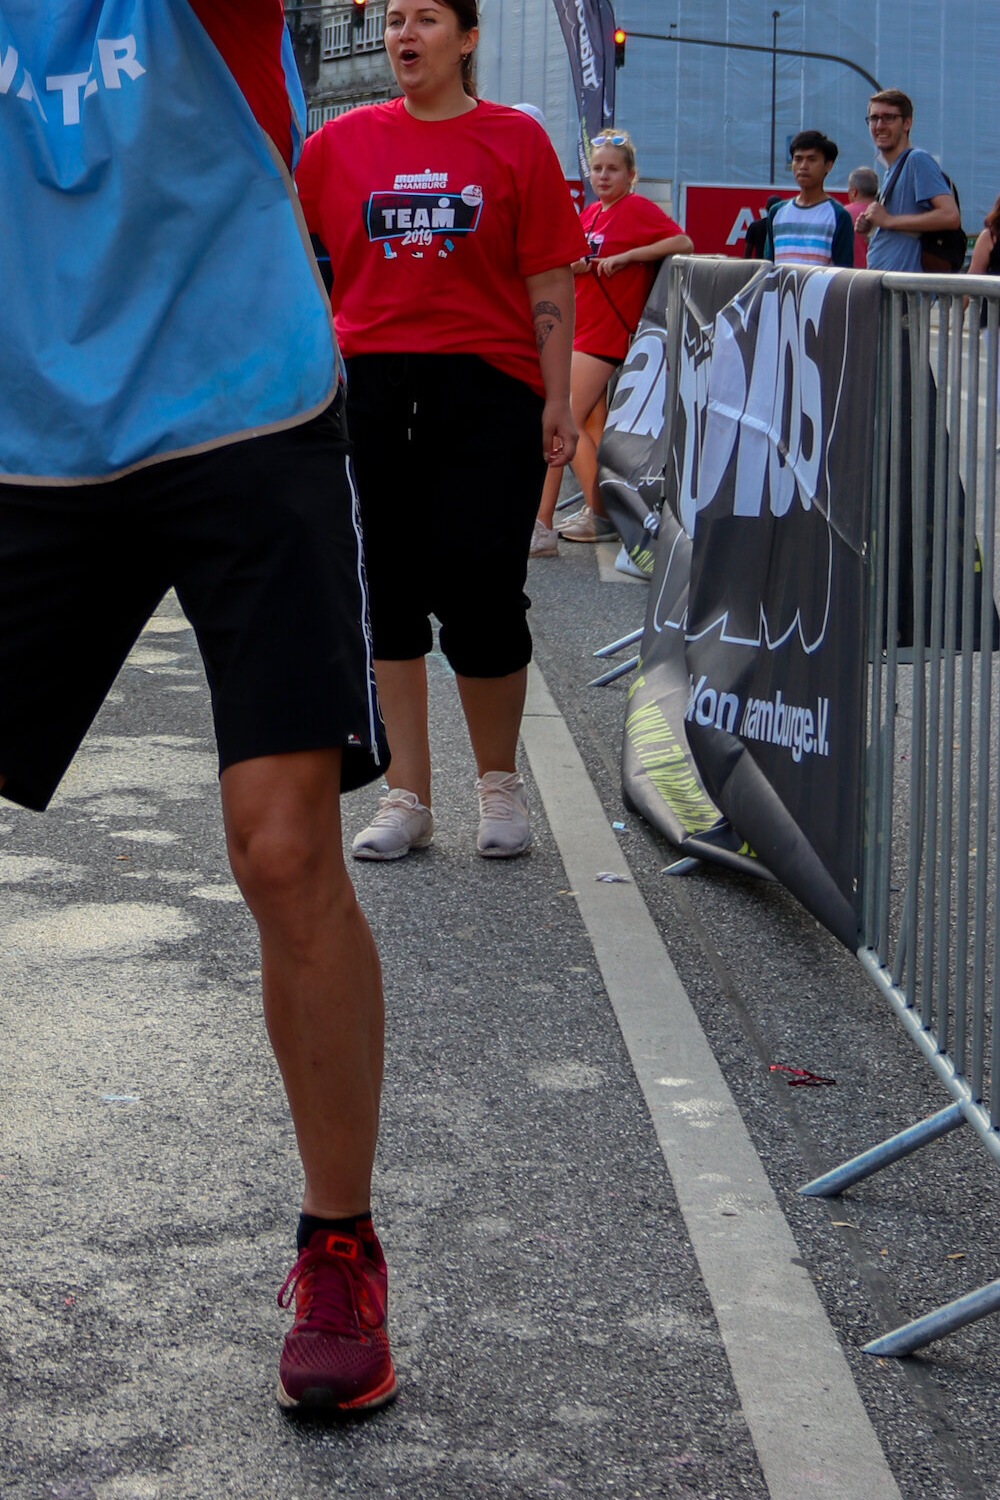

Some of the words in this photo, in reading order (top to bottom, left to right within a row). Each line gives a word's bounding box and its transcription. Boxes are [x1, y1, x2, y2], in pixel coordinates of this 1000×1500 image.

[395, 169, 448, 183] IRONMAN
[401, 181, 447, 190] HAMBURG
[382, 199, 455, 229] TEAM
[725, 207, 768, 246] A
[401, 228, 433, 246] 2019
